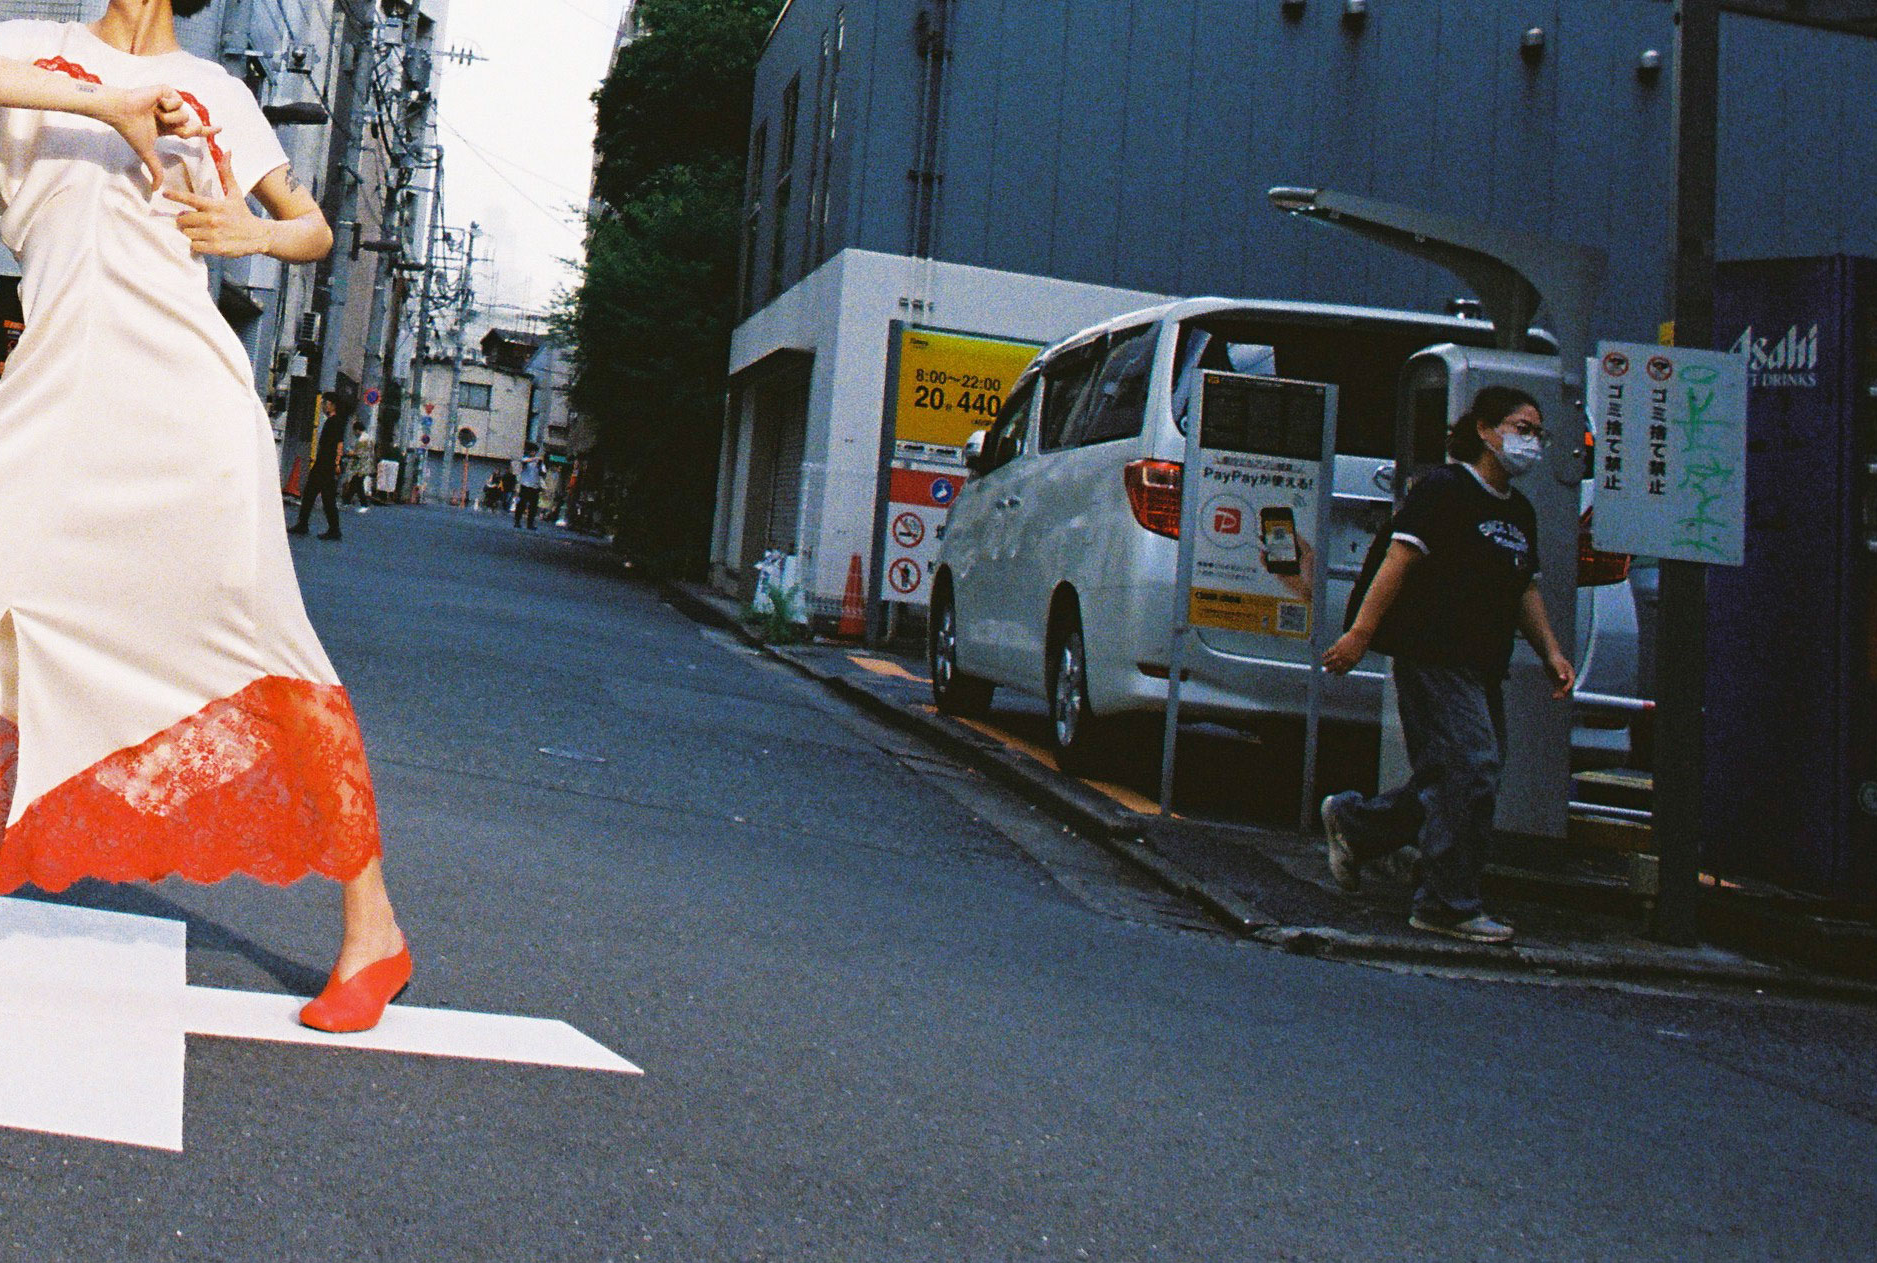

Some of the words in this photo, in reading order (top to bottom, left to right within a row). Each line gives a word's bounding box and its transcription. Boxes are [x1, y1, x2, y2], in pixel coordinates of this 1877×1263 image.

[1728, 323, 1818, 370] Asahi
[1762, 372, 1818, 387] DRINKS
[1603, 384, 1623, 491] ゴミ捨て禁止
[1648, 388, 1668, 496] ゴミ捨て禁止
